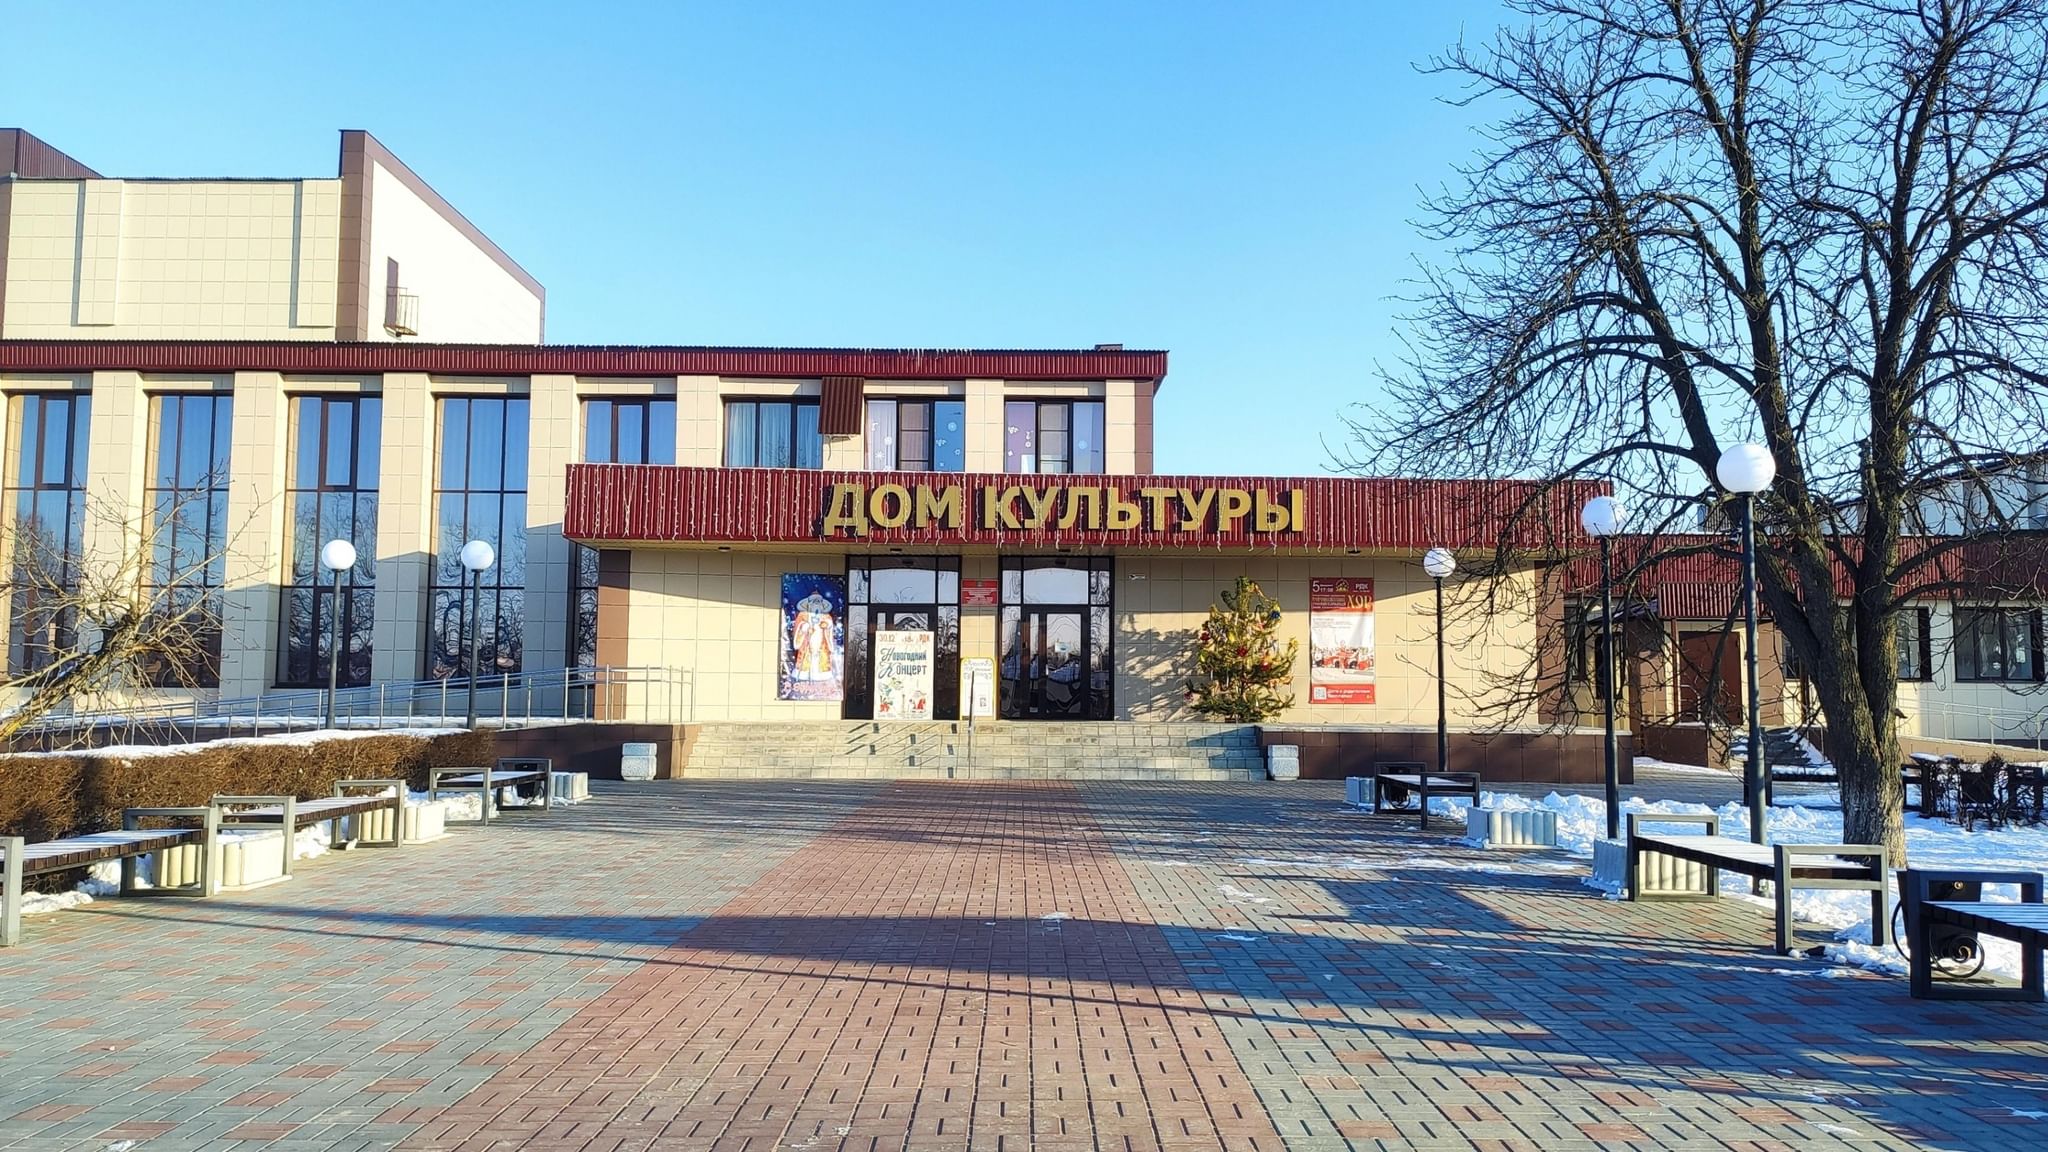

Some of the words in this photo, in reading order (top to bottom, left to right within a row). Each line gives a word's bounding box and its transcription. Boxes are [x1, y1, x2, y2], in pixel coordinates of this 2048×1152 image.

[824, 483, 960, 536] ДОМ
[984, 484, 1304, 532] КУЛЬТУРЫ
[1312, 580, 1320, 593] 5
[880, 647, 927, 662] Новогодний
[878, 661, 928, 679] Концерт
